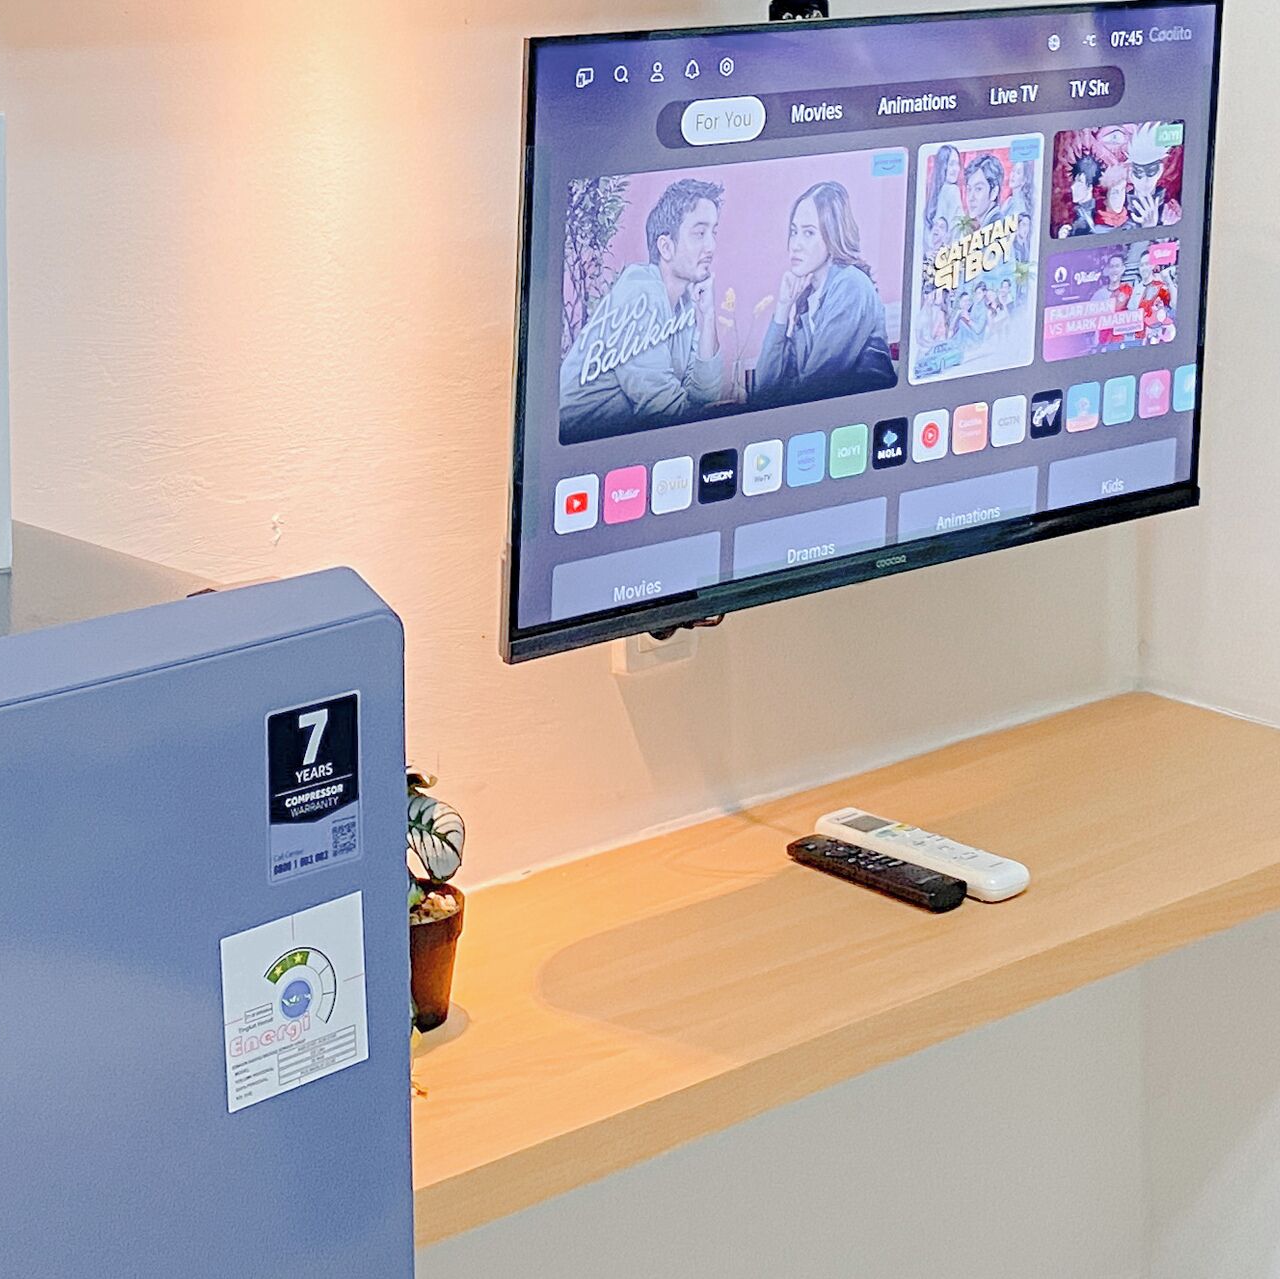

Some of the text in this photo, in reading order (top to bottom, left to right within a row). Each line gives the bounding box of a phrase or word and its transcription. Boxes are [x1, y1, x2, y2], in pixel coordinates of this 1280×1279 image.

[1111, 30, 1143, 47] 07:45
[990, 85, 1038, 106] Live TV
[1069, 80, 1086, 98] TV
[791, 102, 843, 124] Movies
[878, 92, 957, 116] Animations
[696, 111, 752, 131] For You
[934, 214, 1019, 270] CATATAN
[934, 234, 1014, 291] SI BOY
[580, 292, 647, 350] Ayo
[1049, 323, 1063, 335] VS
[1067, 318, 1097, 332] MARK
[580, 297, 696, 385] Balikan
[878, 447, 902, 460] MOLA
[1102, 478, 1124, 495] Kids
[936, 505, 1001, 531] Animations
[787, 542, 836, 565] Dramas
[613, 579, 662, 603] Movies
[299, 708, 328, 766] 7
[295, 762, 333, 784] YEARS
[285, 783, 344, 808] COMPRESSOR
[290, 796, 339, 818] WARRANTY
[229, 1010, 311, 1058] Energi
